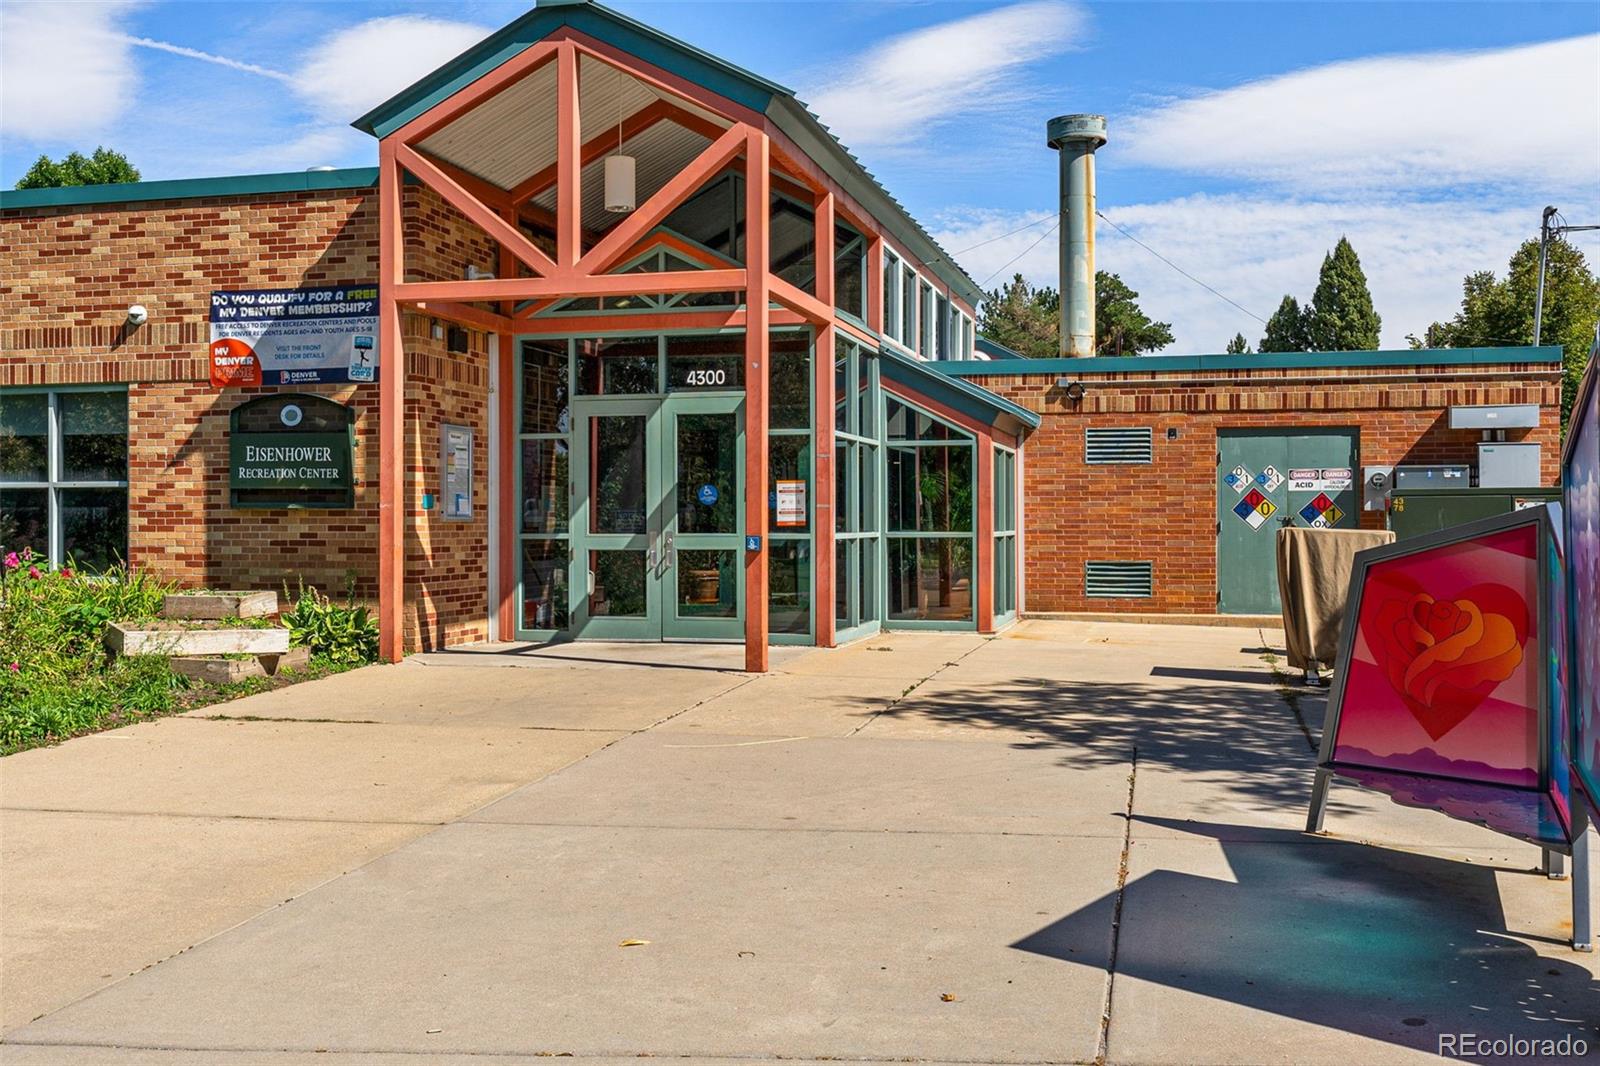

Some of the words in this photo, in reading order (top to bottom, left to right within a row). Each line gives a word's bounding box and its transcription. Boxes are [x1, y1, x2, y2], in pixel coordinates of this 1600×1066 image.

[212, 295, 228, 305] DO
[231, 294, 255, 305] YOU
[258, 292, 306, 304] QUALIFY
[308, 291, 333, 302] FOR
[335, 290, 344, 301] A
[347, 288, 377, 300] FREE
[219, 307, 237, 318] MY
[240, 305, 285, 317] DENVER
[288, 302, 373, 315] MEMBERSHIP?
[214, 347, 229, 356] MY
[214, 356, 254, 366] DENVER
[291, 371, 318, 379] DENVER
[687, 369, 725, 386] 4300
[246, 446, 332, 462] EISENHOWER
[239, 467, 297, 479] RECREATION
[299, 467, 339, 479] CENTER
[1261, 502, 1270, 515] 0
[1393, 504, 1404, 512] 78
[1314, 520, 1328, 528] OX
